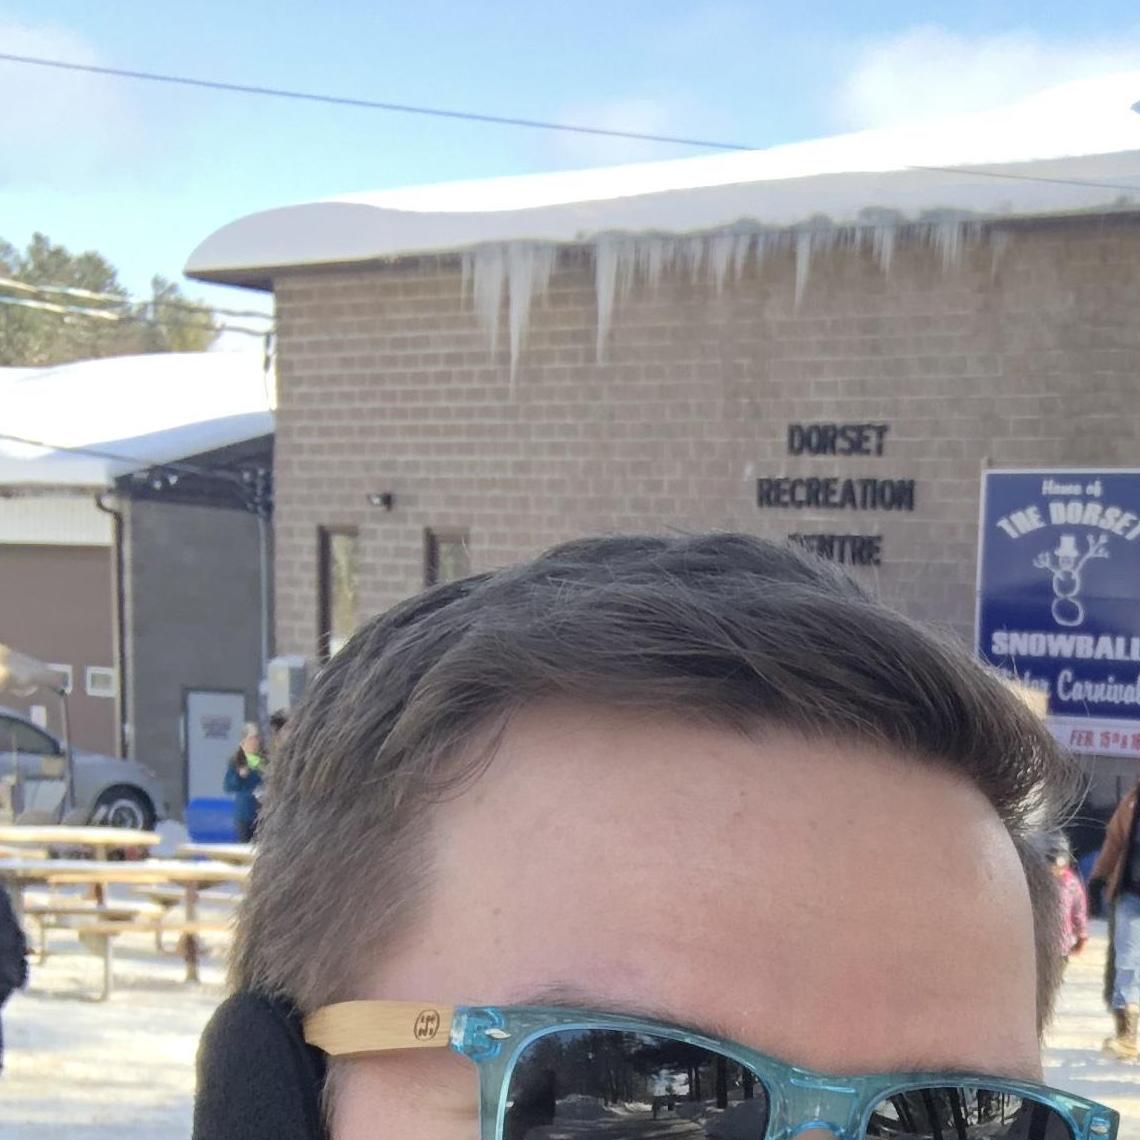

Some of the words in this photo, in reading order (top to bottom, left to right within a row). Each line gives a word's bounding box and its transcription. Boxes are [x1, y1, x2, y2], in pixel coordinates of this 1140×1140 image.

[788, 423, 889, 456] DORSET
[757, 477, 914, 511] RECREATION
[996, 505, 1047, 539] THE
